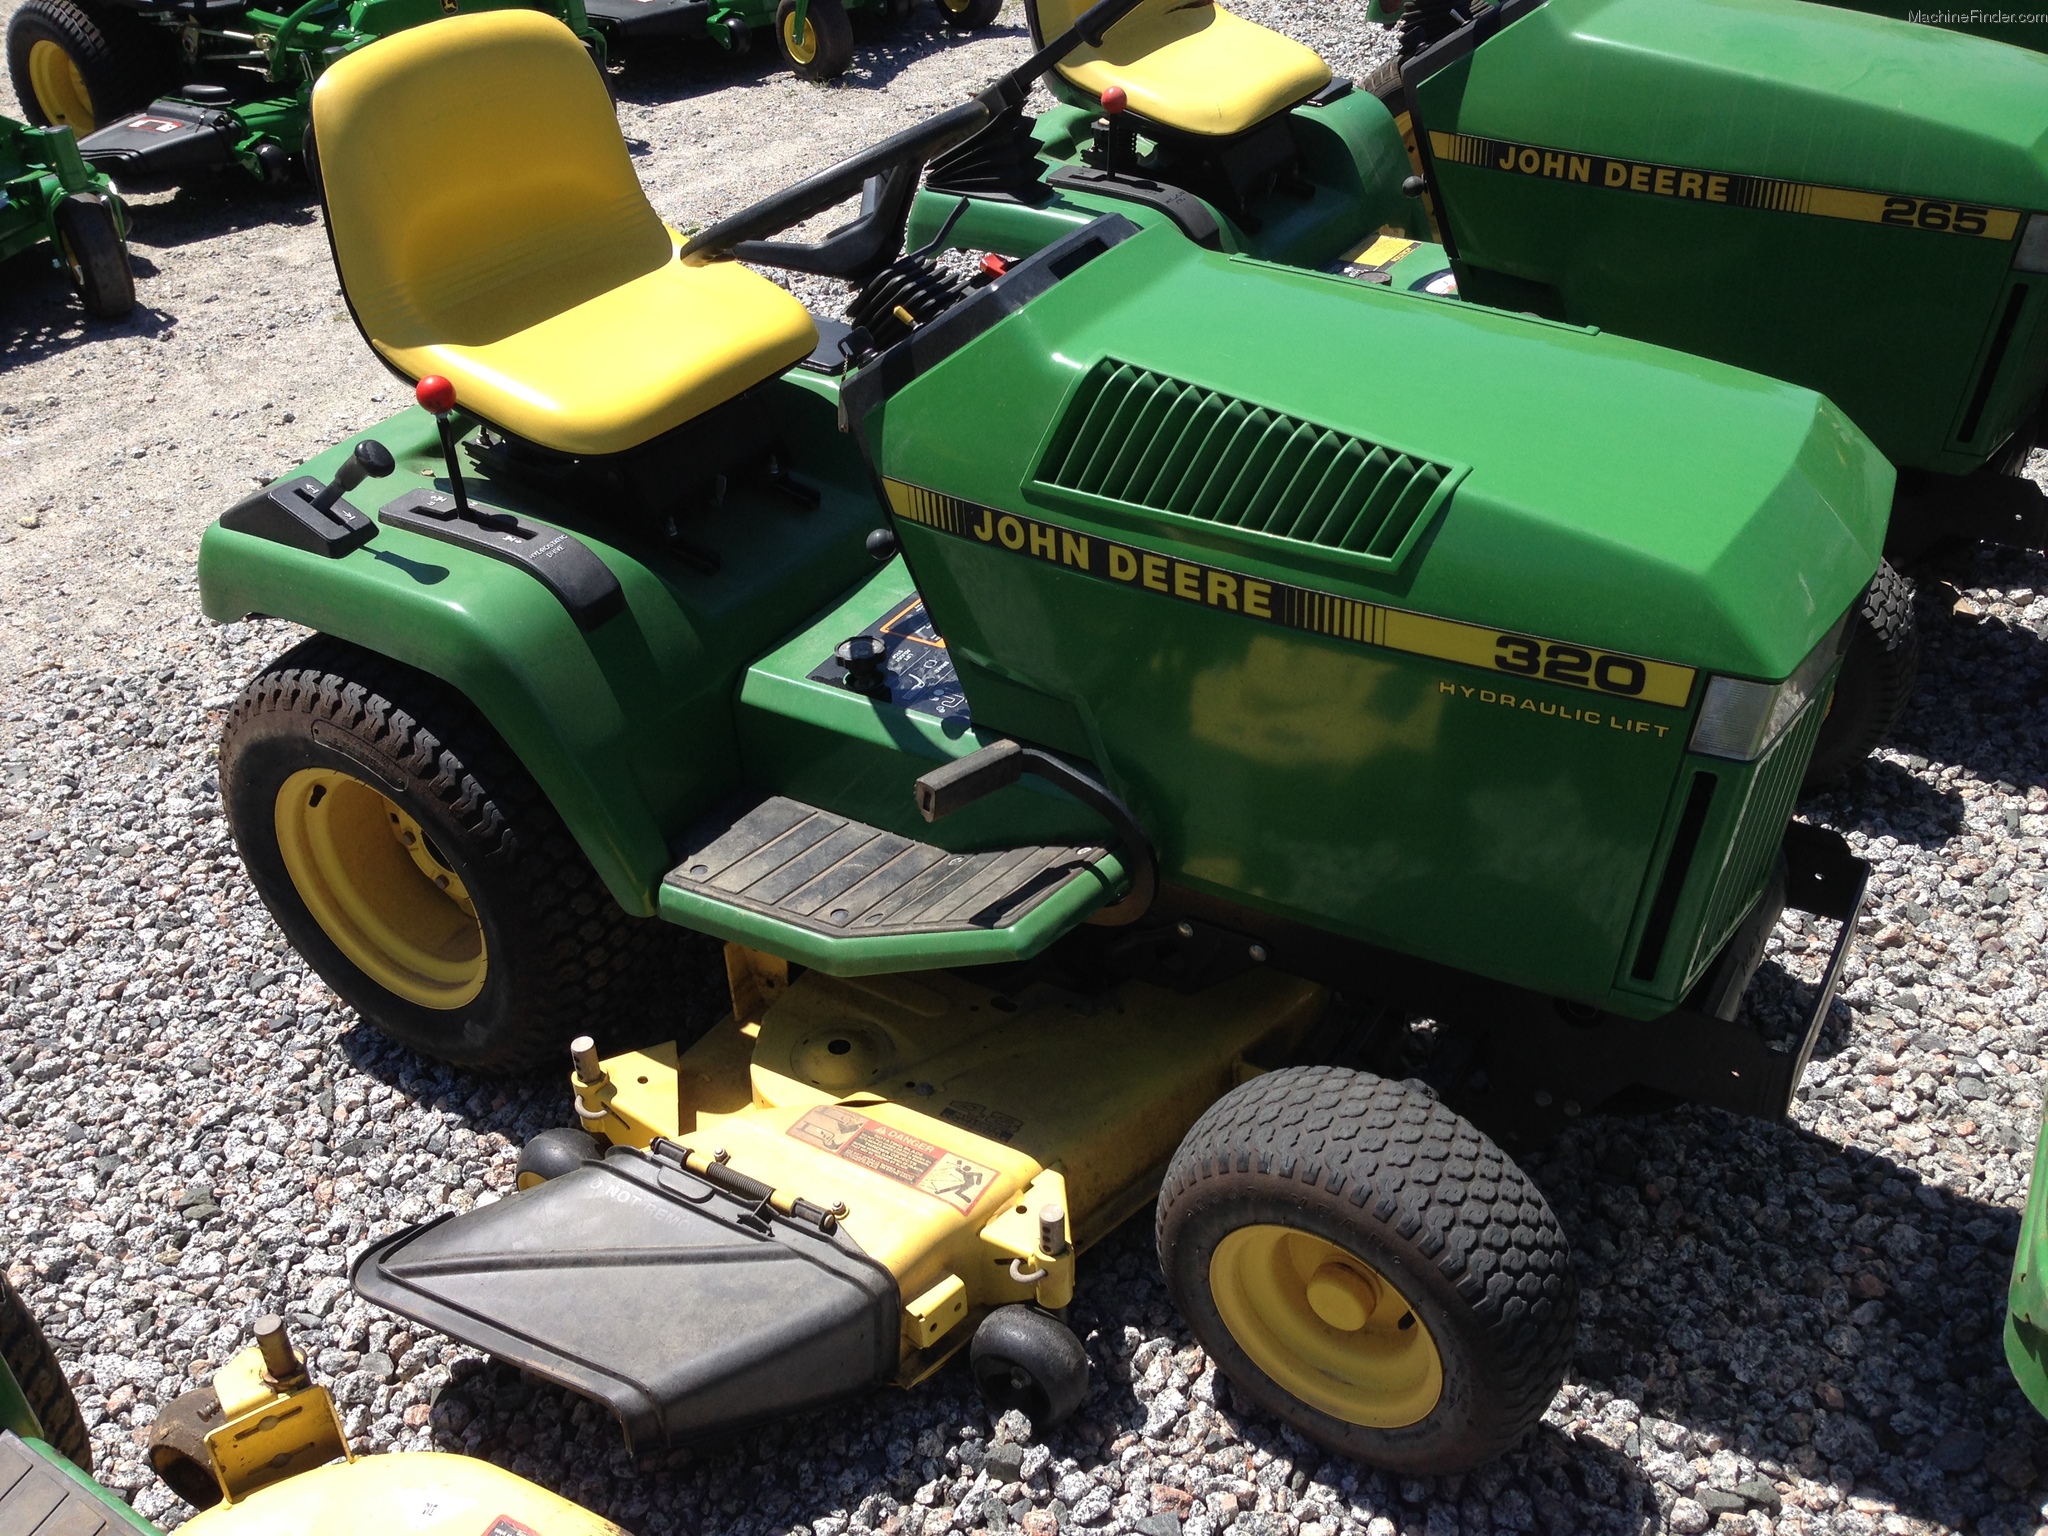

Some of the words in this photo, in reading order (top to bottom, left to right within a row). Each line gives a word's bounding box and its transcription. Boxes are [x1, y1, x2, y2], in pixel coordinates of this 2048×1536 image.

[1499, 146, 1591, 183] JOHN
[1604, 161, 1730, 202] DEERE
[1881, 197, 1988, 235] 265
[973, 510, 1090, 570] JOHN
[1108, 544, 1272, 619] DEERE
[1494, 635, 1646, 696] 320
[1439, 681, 1602, 725] HYDRAULIC
[1610, 716, 1670, 738] LIFT
[886, 1129, 935, 1153] DANGER
[604, 1184, 642, 1208] NOT
